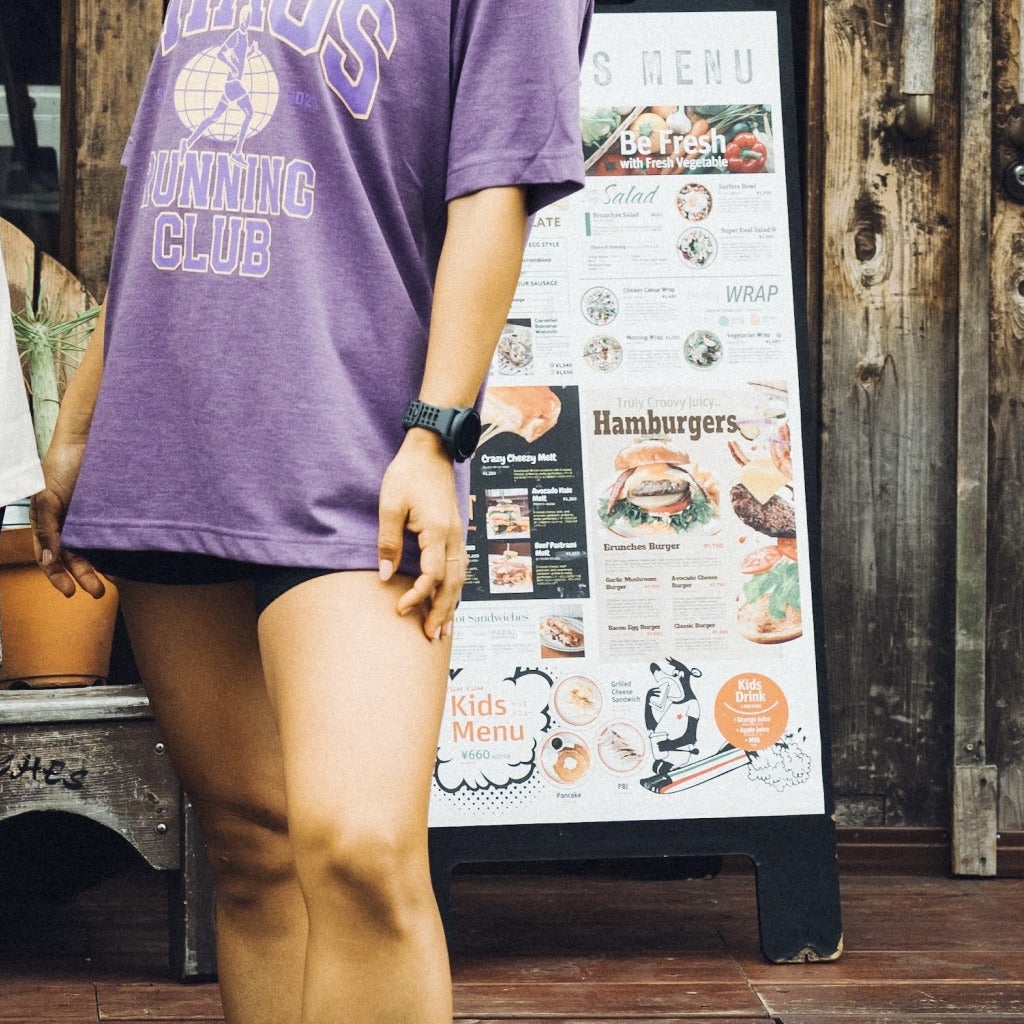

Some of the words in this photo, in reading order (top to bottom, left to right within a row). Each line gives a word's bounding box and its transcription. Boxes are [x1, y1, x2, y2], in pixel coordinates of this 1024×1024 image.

[642, 48, 754, 86] MENU
[620, 130, 652, 155] Be
[659, 128, 727, 155] Fresh
[620, 158, 644, 169] with
[646, 157, 675, 169] Fresh
[676, 156, 728, 170] Vegetable
[603, 184, 661, 206] Salad
[152, 212, 272, 278] CLUB
[726, 284, 779, 304] WRAP
[617, 397, 645, 410] Truly
[647, 396, 687, 409] Groovy
[593, 409, 737, 441] Hamburgers
[481, 454, 506, 465] Crazy
[538, 453, 557, 462] Melt
[604, 543, 647, 552] Brunches
[649, 542, 680, 552] Burger
[611, 680, 632, 688] Grilled
[738, 678, 763, 690] Kids
[611, 695, 641, 703] Sandwich
[736, 690, 767, 702] Drink
[451, 693, 507, 716] Kids
[453, 721, 525, 743] Menu
[461, 749, 490, 760] ¥660
[557, 791, 582, 799] Pancake
